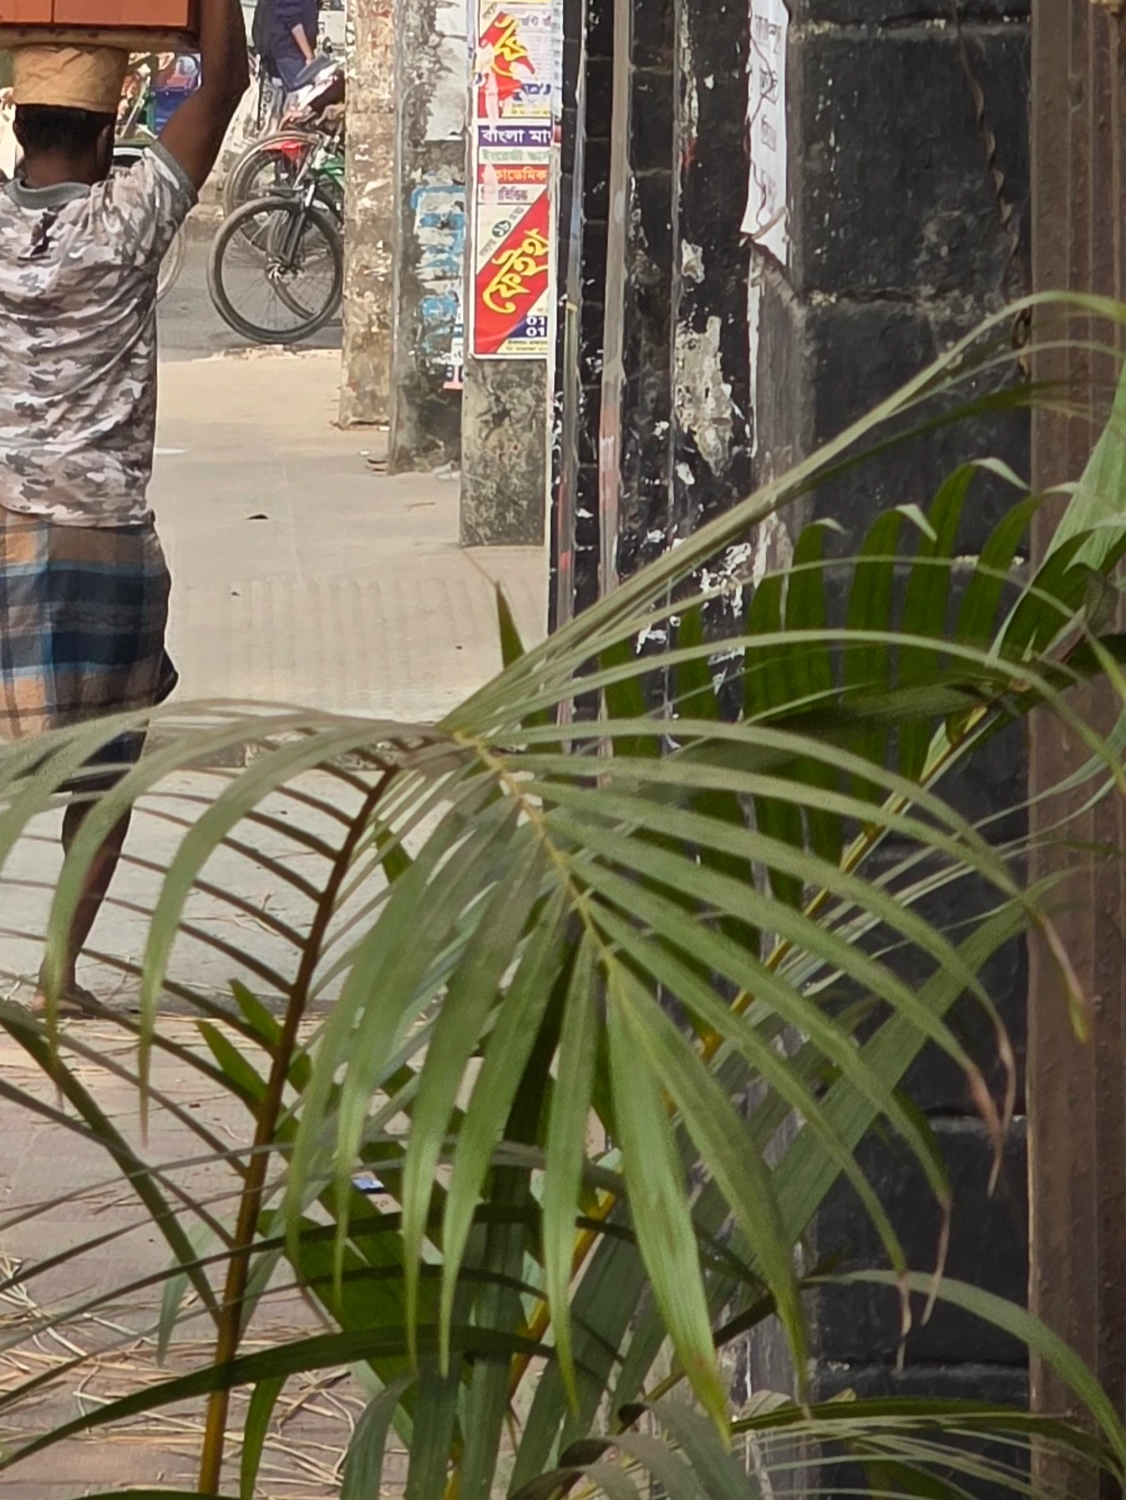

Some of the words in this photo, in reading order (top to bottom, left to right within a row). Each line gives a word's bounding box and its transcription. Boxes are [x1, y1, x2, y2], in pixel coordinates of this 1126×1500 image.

[480, 128, 525, 143] বাংলা
[481, 166, 548, 181] কাডেমিক
[526, 315, 546, 326] 01
[526, 327, 546, 337] 01
